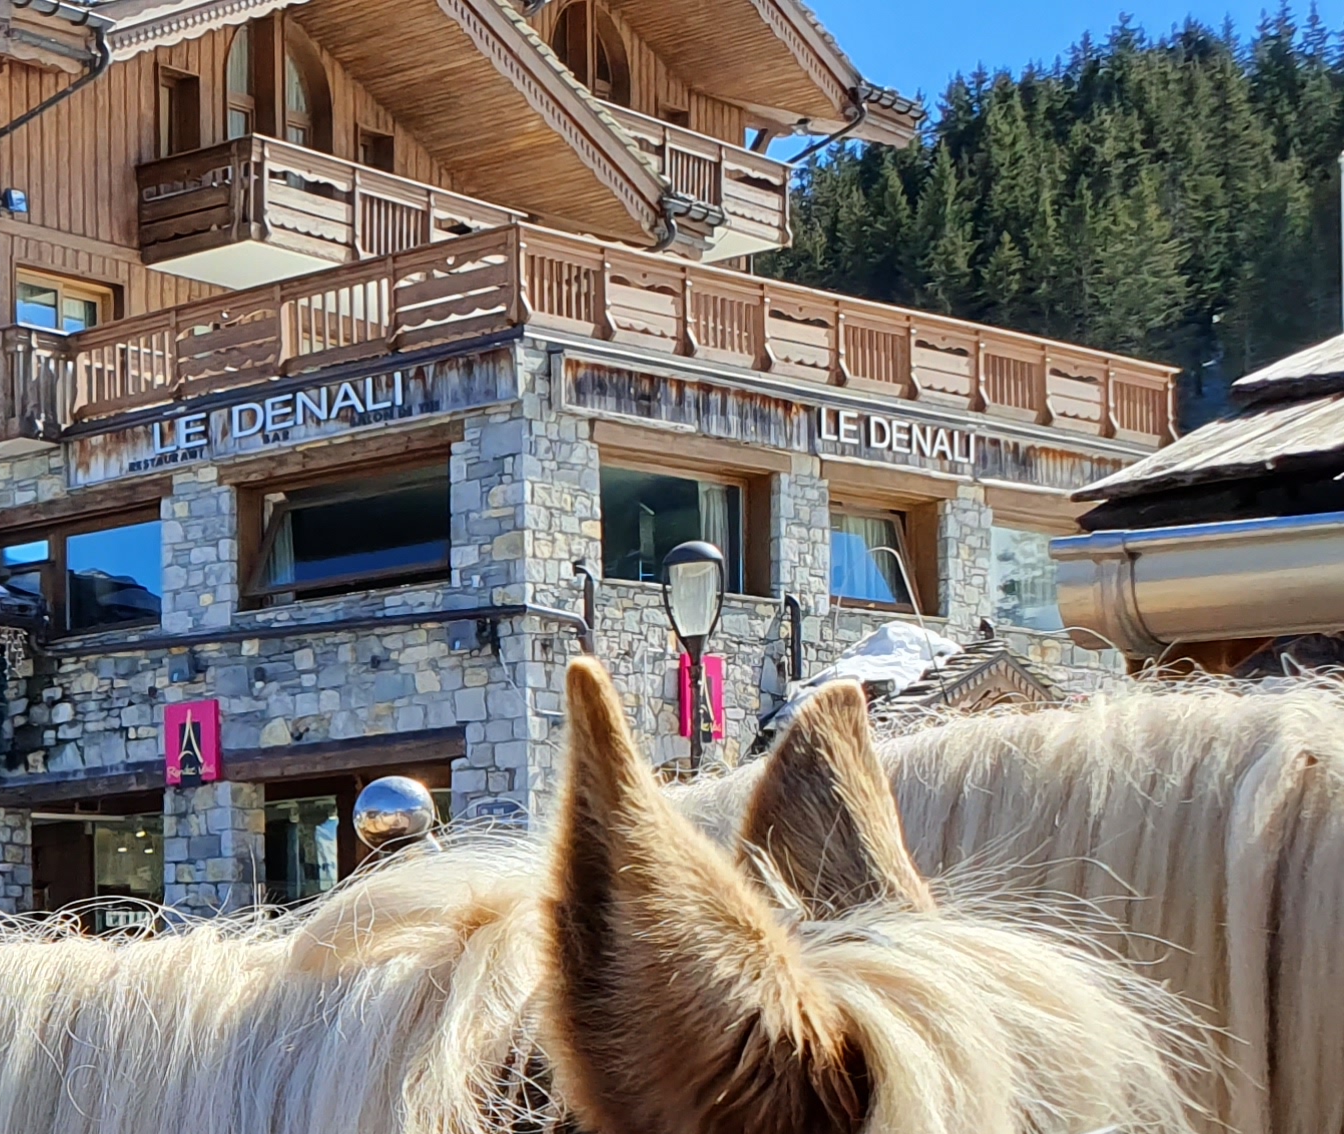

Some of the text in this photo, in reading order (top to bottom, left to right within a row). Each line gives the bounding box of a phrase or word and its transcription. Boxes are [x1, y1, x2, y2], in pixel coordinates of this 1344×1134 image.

[153, 371, 404, 454] LE DENALI
[263, 430, 290, 445] BAR
[820, 406, 975, 464] LE DENALI
[128, 449, 204, 472] RESTAURANT
